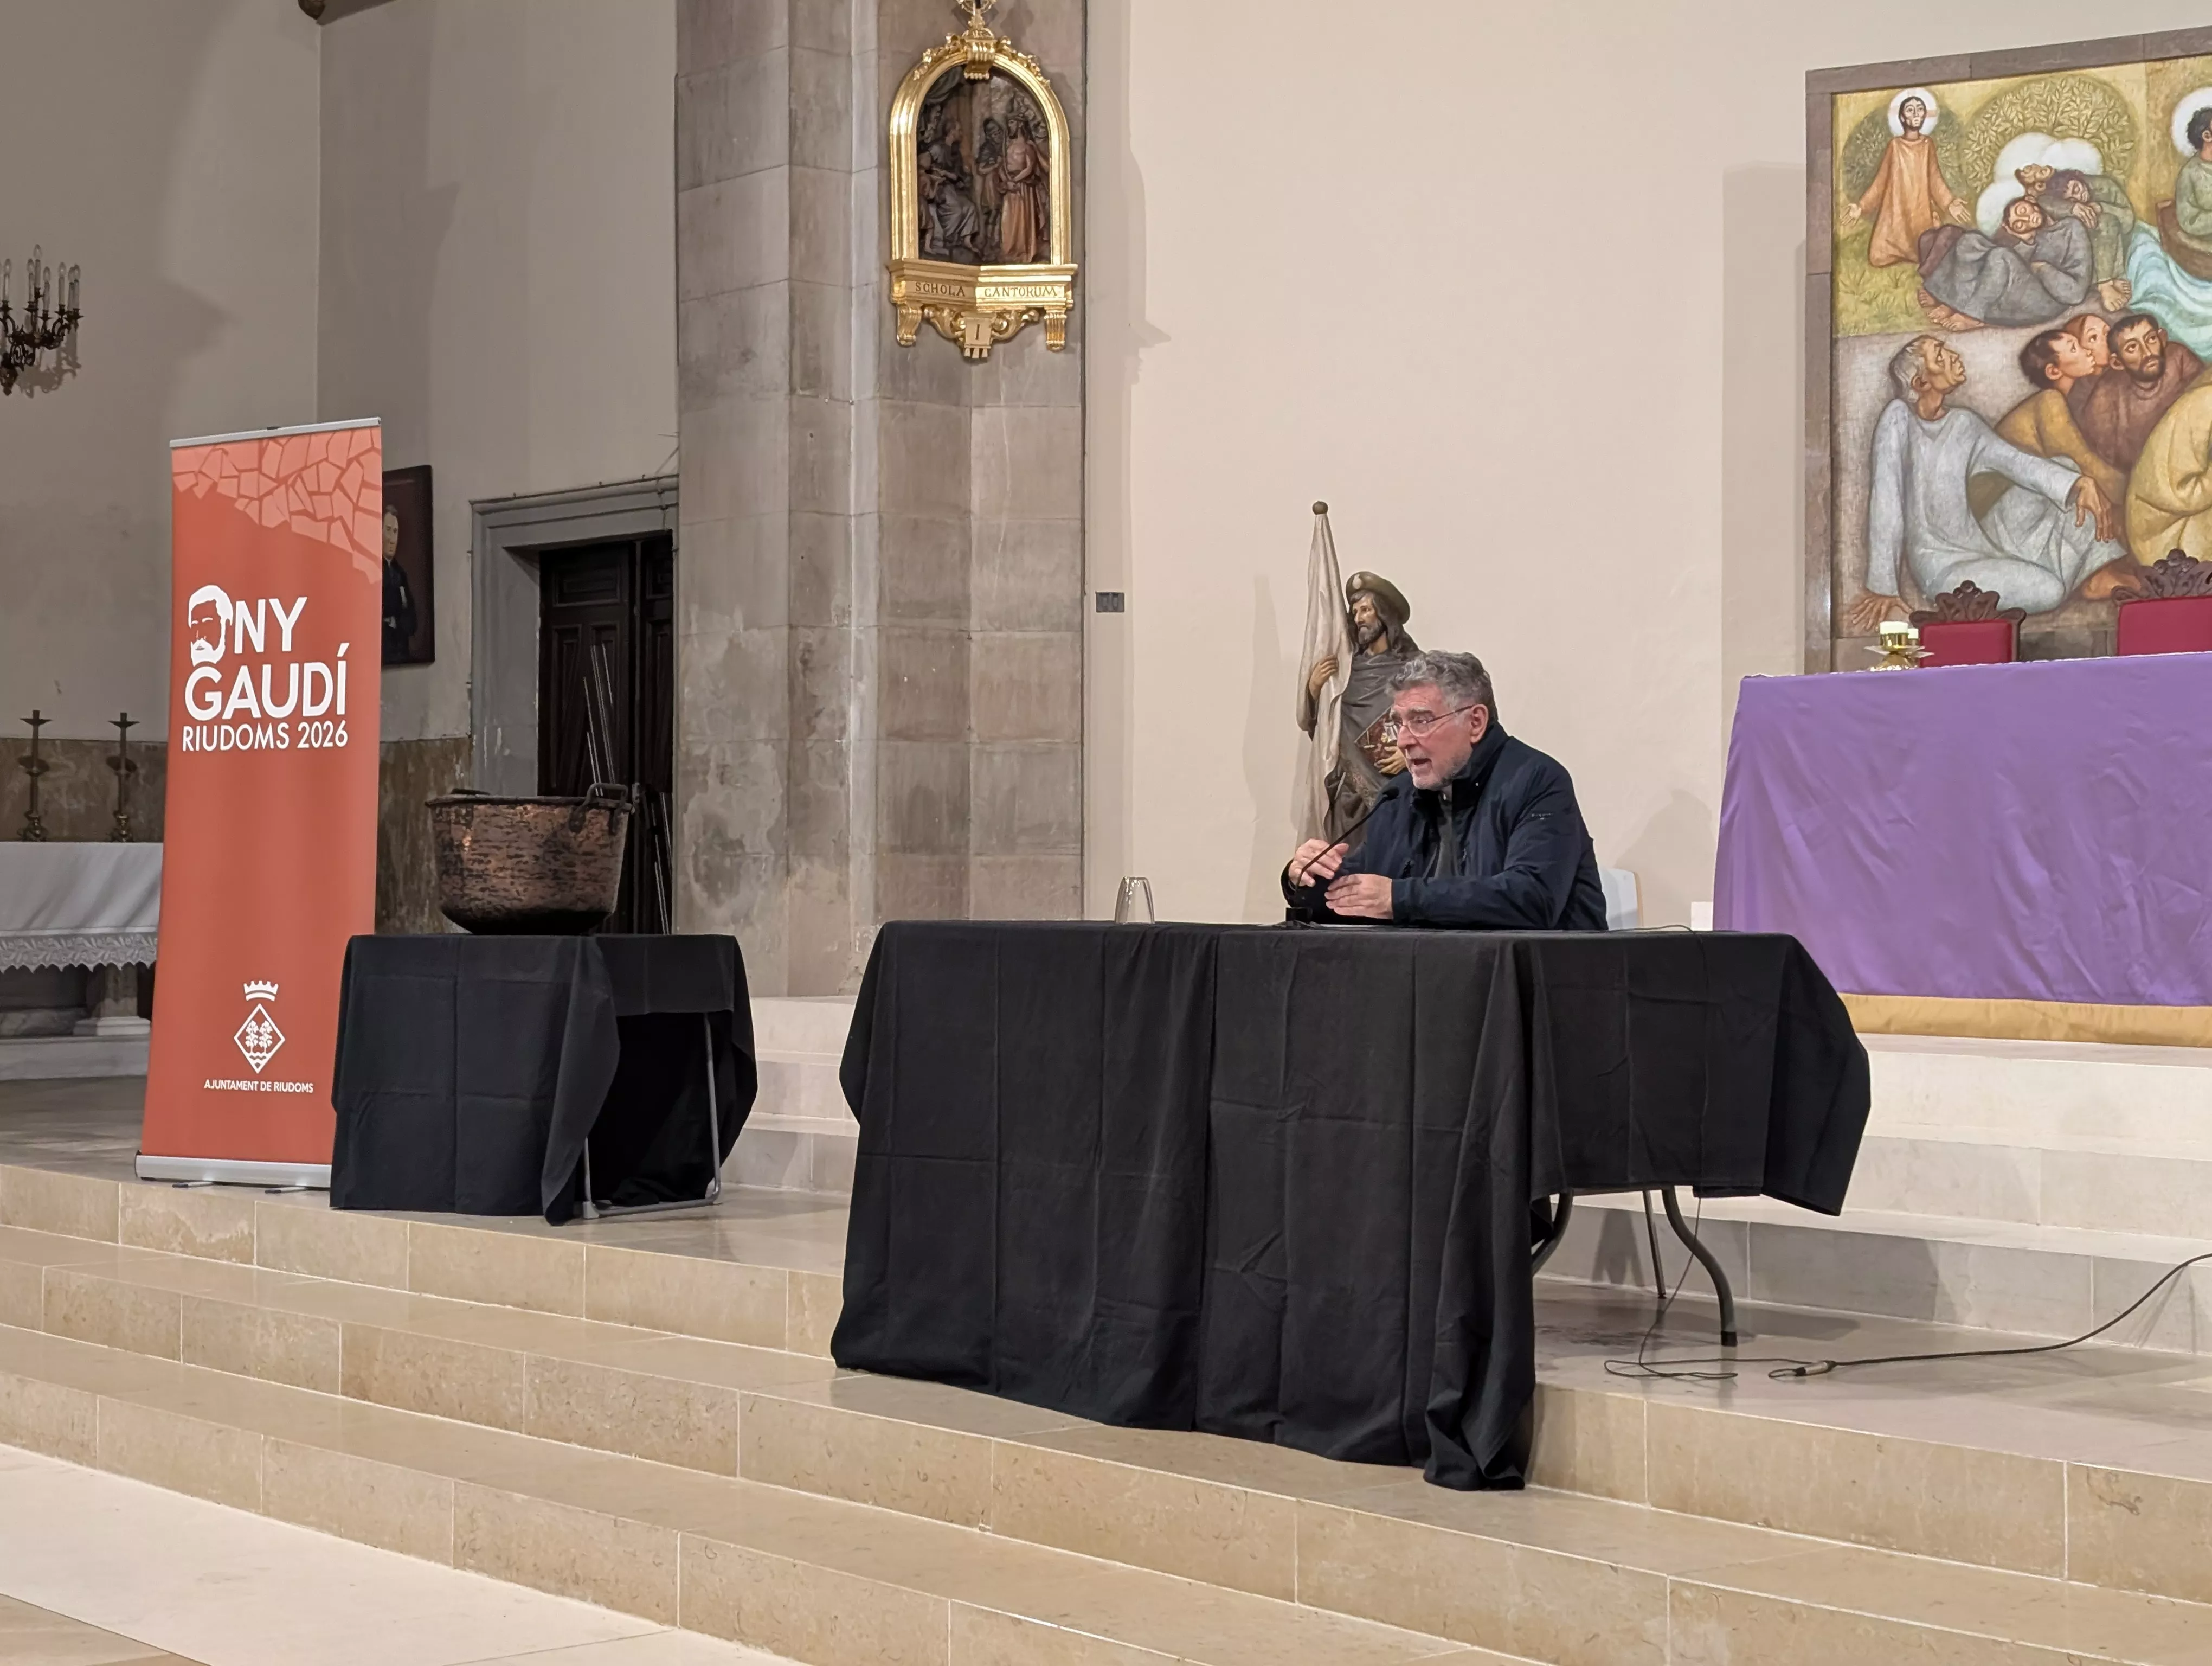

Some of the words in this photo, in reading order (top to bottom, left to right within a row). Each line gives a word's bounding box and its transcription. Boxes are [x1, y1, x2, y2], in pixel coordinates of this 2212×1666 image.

[915, 281, 966, 297] SCHOLA
[984, 286, 1057, 297] CANTORUM
[185, 642, 350, 721] GAUDÍ
[182, 722, 290, 752] RIUDOMS
[297, 720, 348, 748] 2026
[203, 1079, 259, 1091] AJUNTAMENT
[260, 1081, 272, 1092] DE
[273, 1081, 314, 1093] RIUDOMS
